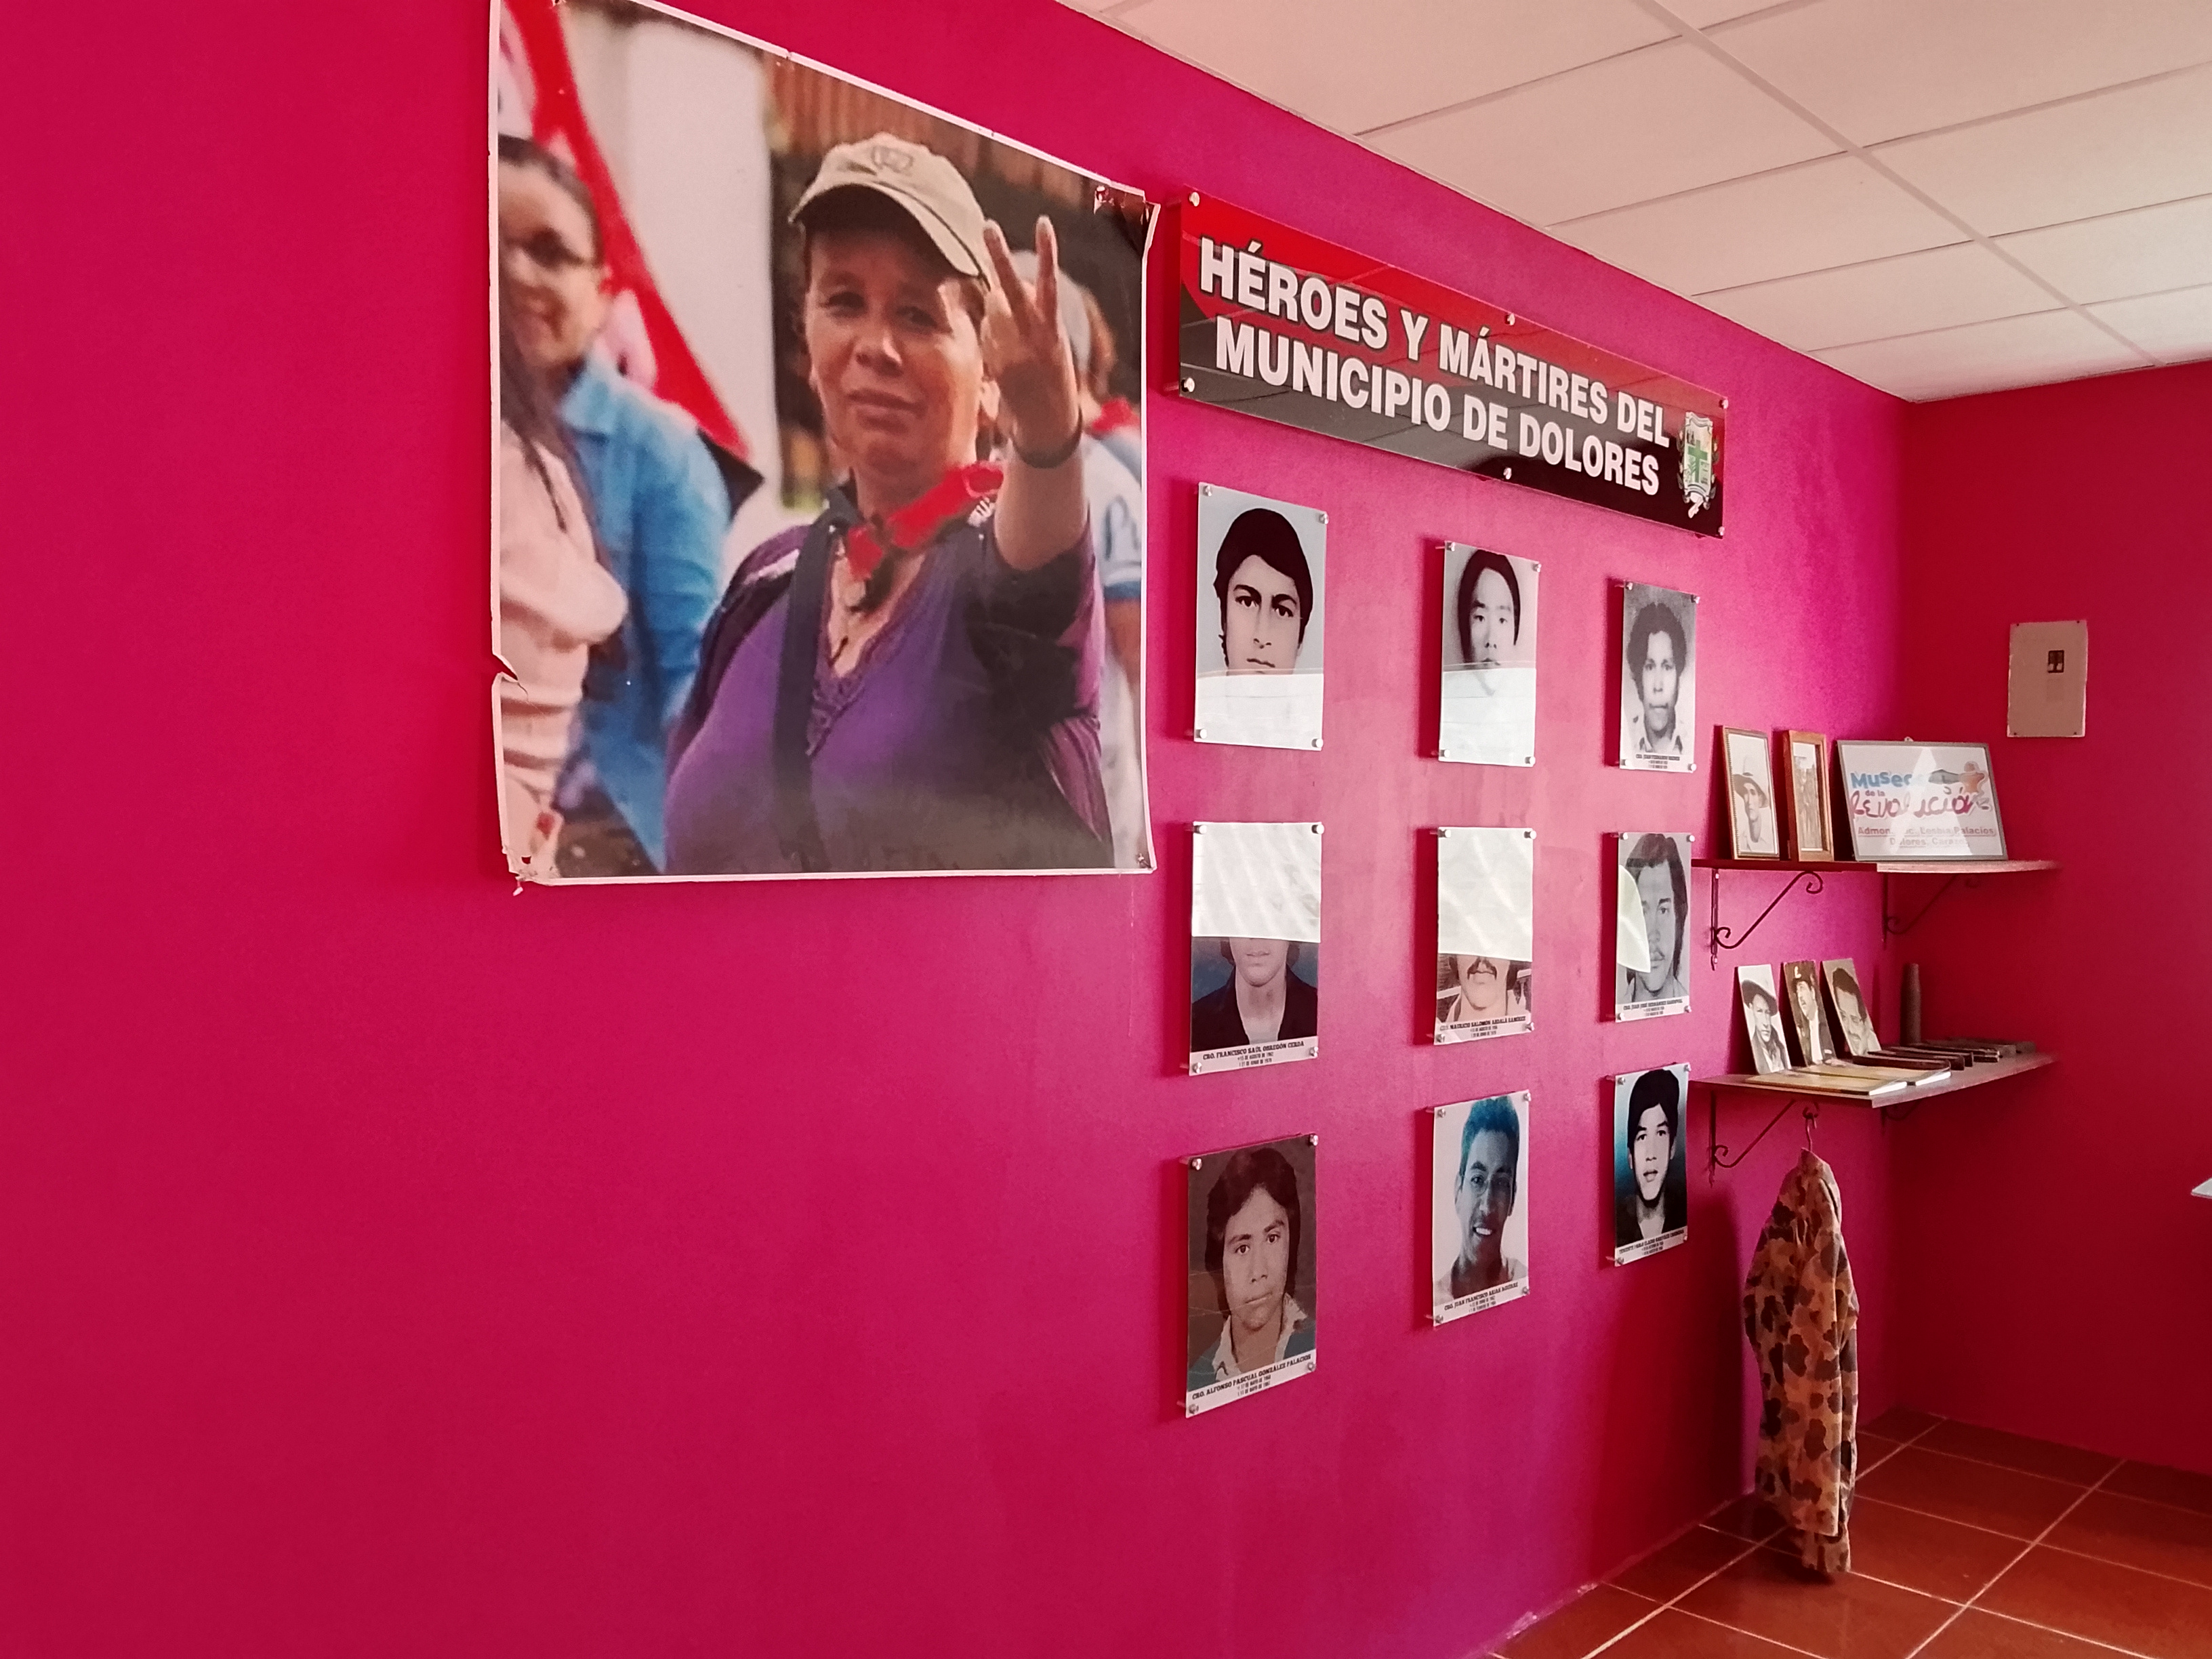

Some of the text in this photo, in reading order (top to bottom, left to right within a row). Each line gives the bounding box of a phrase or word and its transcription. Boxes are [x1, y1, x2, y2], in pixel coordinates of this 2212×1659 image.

[1200, 237, 1669, 447] HÉROES Y MÁRTIRES DEL
[1216, 316, 1659, 495] MUNICIPIO DE DOLORES
[1954, 826, 1994, 835] Palacios
[1216, 1048, 1247, 1059] FRANCISCO
[1206, 1382, 1232, 1395] ALFONSO
[1233, 1374, 1257, 1387] PASCUAL
[1258, 1364, 1286, 1377] GONZÁLEZ
[1287, 1354, 1311, 1367] PALACIOS
